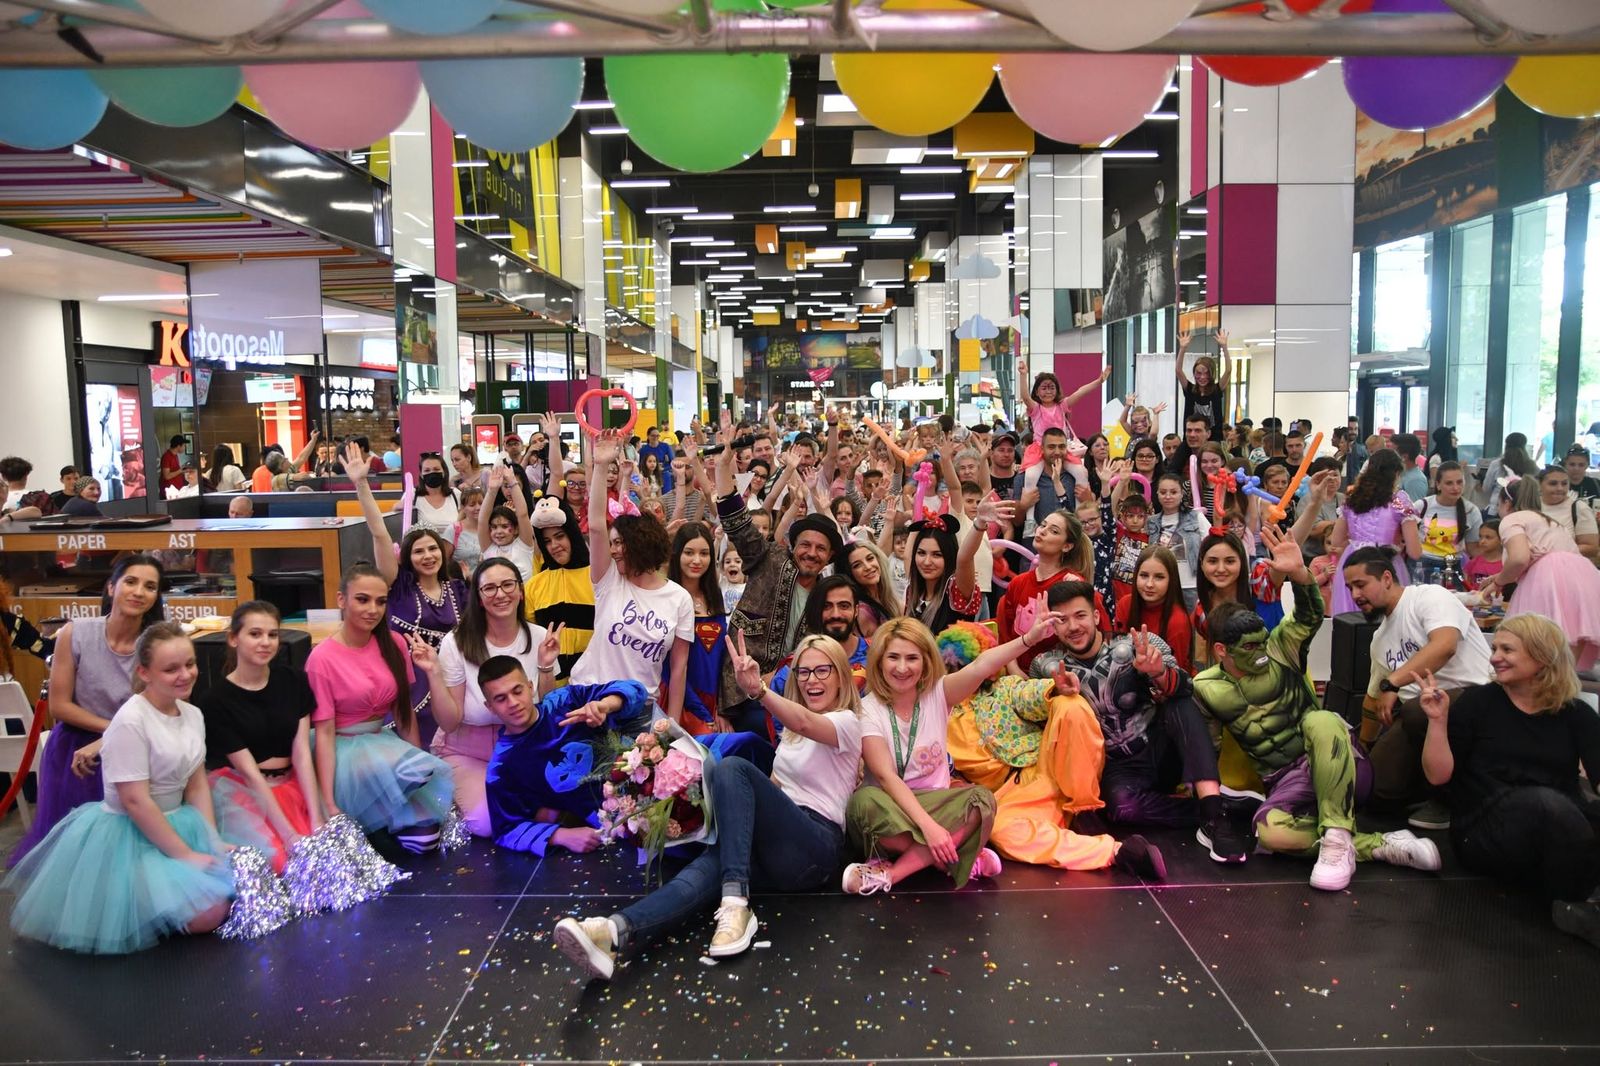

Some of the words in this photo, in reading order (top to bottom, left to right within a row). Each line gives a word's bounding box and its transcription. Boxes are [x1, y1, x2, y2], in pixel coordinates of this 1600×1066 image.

[790, 380, 835, 388] STARBKS
[57, 534, 106, 550] PAPER
[168, 533, 196, 549] AST
[60, 601, 102, 619] HÂRTI
[622, 599, 669, 635] Balos
[1386, 638, 1420, 672] Balos
